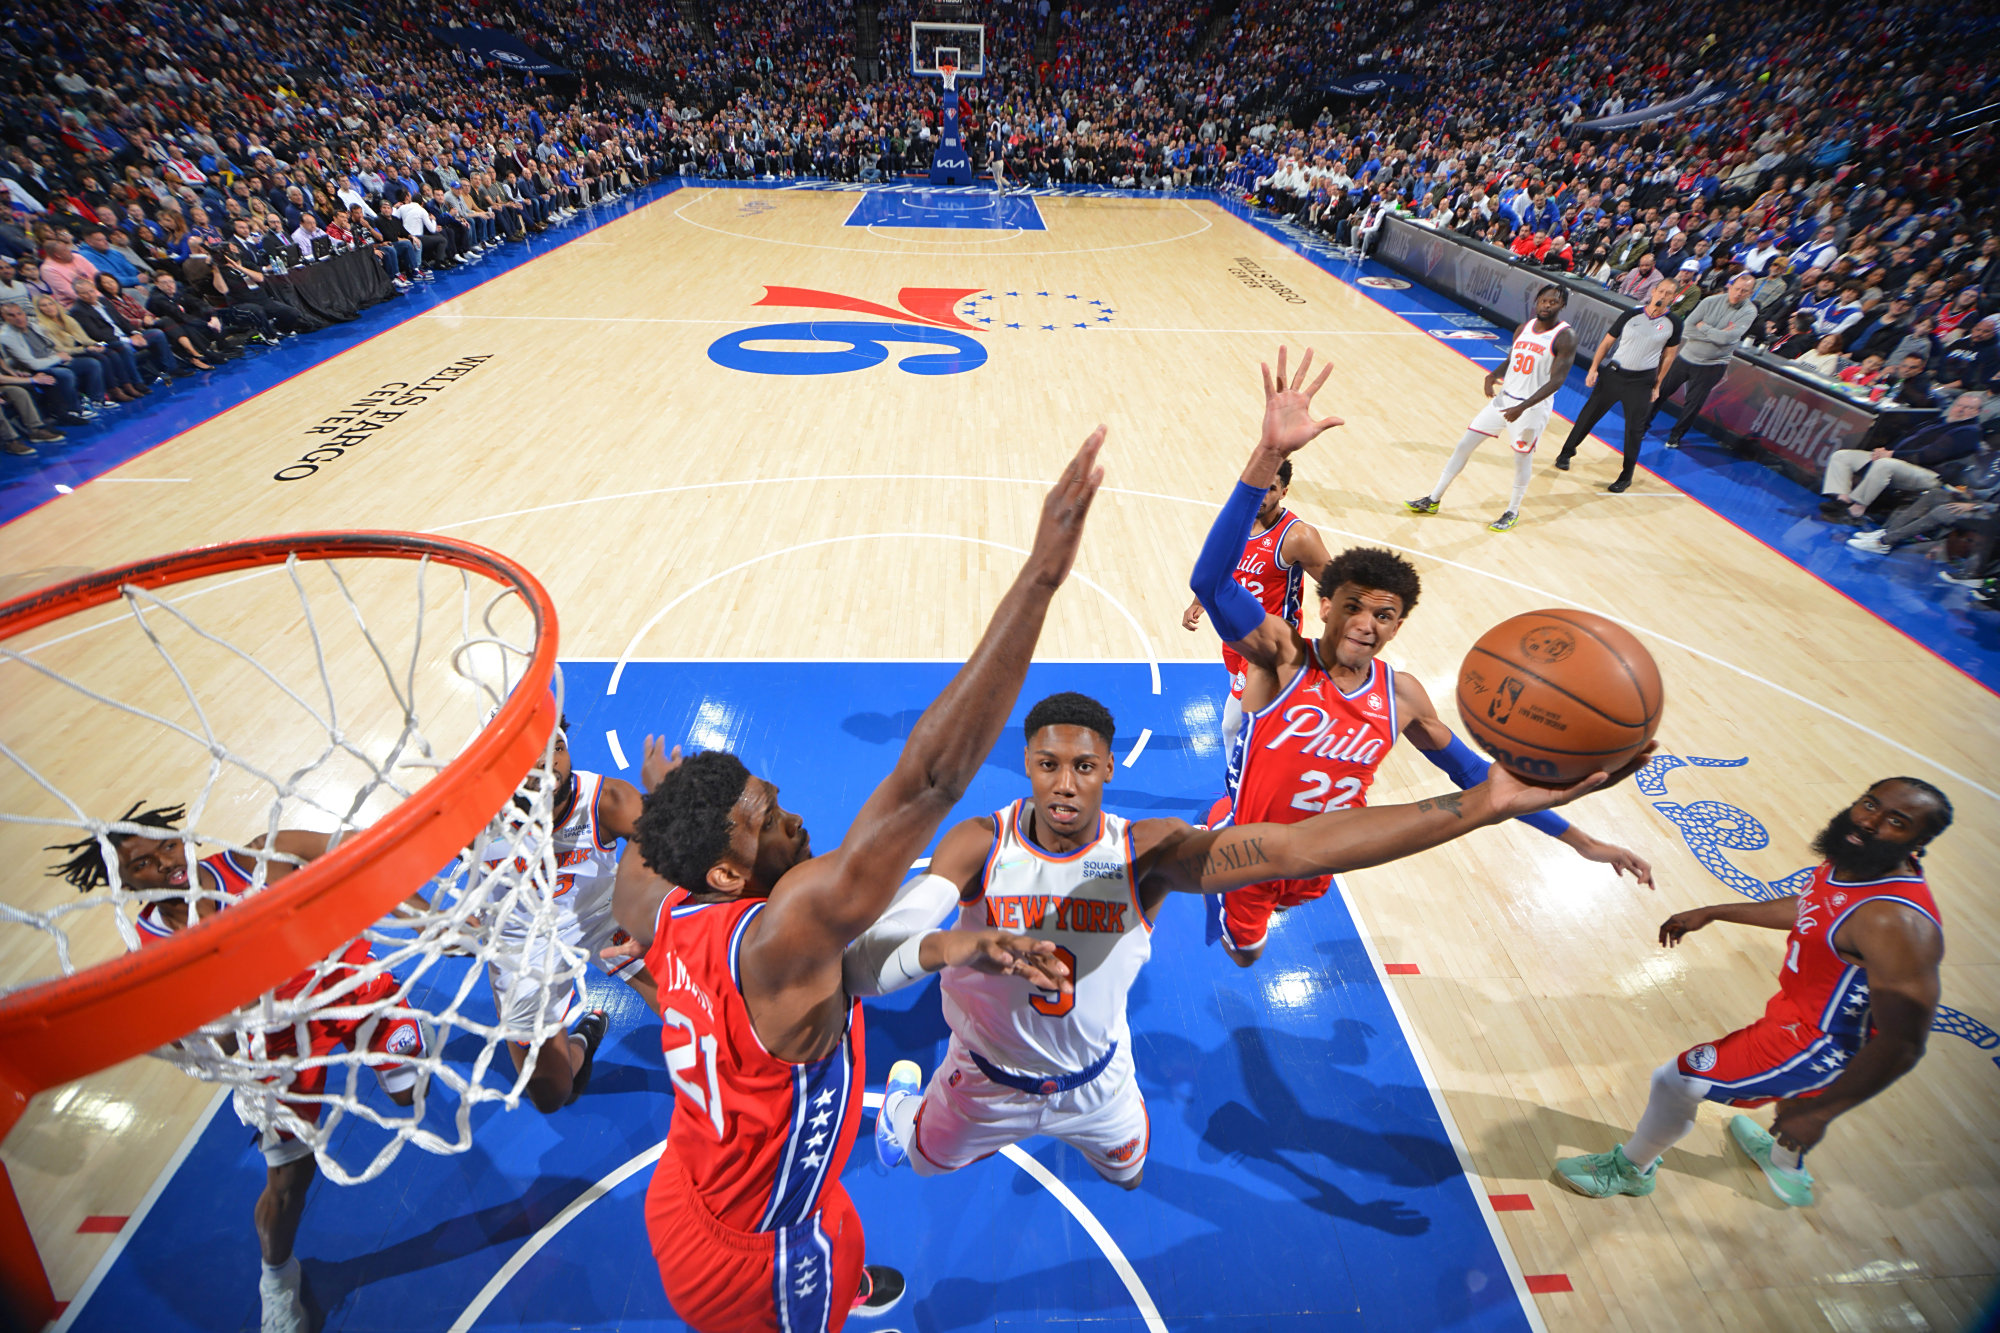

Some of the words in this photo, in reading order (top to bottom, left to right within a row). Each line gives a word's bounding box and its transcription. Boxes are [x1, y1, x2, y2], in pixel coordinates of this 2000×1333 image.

[390, 353, 495, 407] WELLS
[1513, 353, 1535, 375] 30
[304, 382, 409, 435] CENTER
[1751, 394, 1853, 467] #NBA75
[273, 410, 408, 482] FARGO
[1265, 704, 1385, 766] Phila
[1289, 769, 1362, 814] 22
[1083, 860, 1123, 872] SQUARE
[1083, 869, 1115, 880] SPACE
[985, 895, 1049, 930] NEW
[1050, 895, 1129, 934] YORK
[1786, 940, 1800, 974] 1
[664, 1006, 725, 1141] 21
